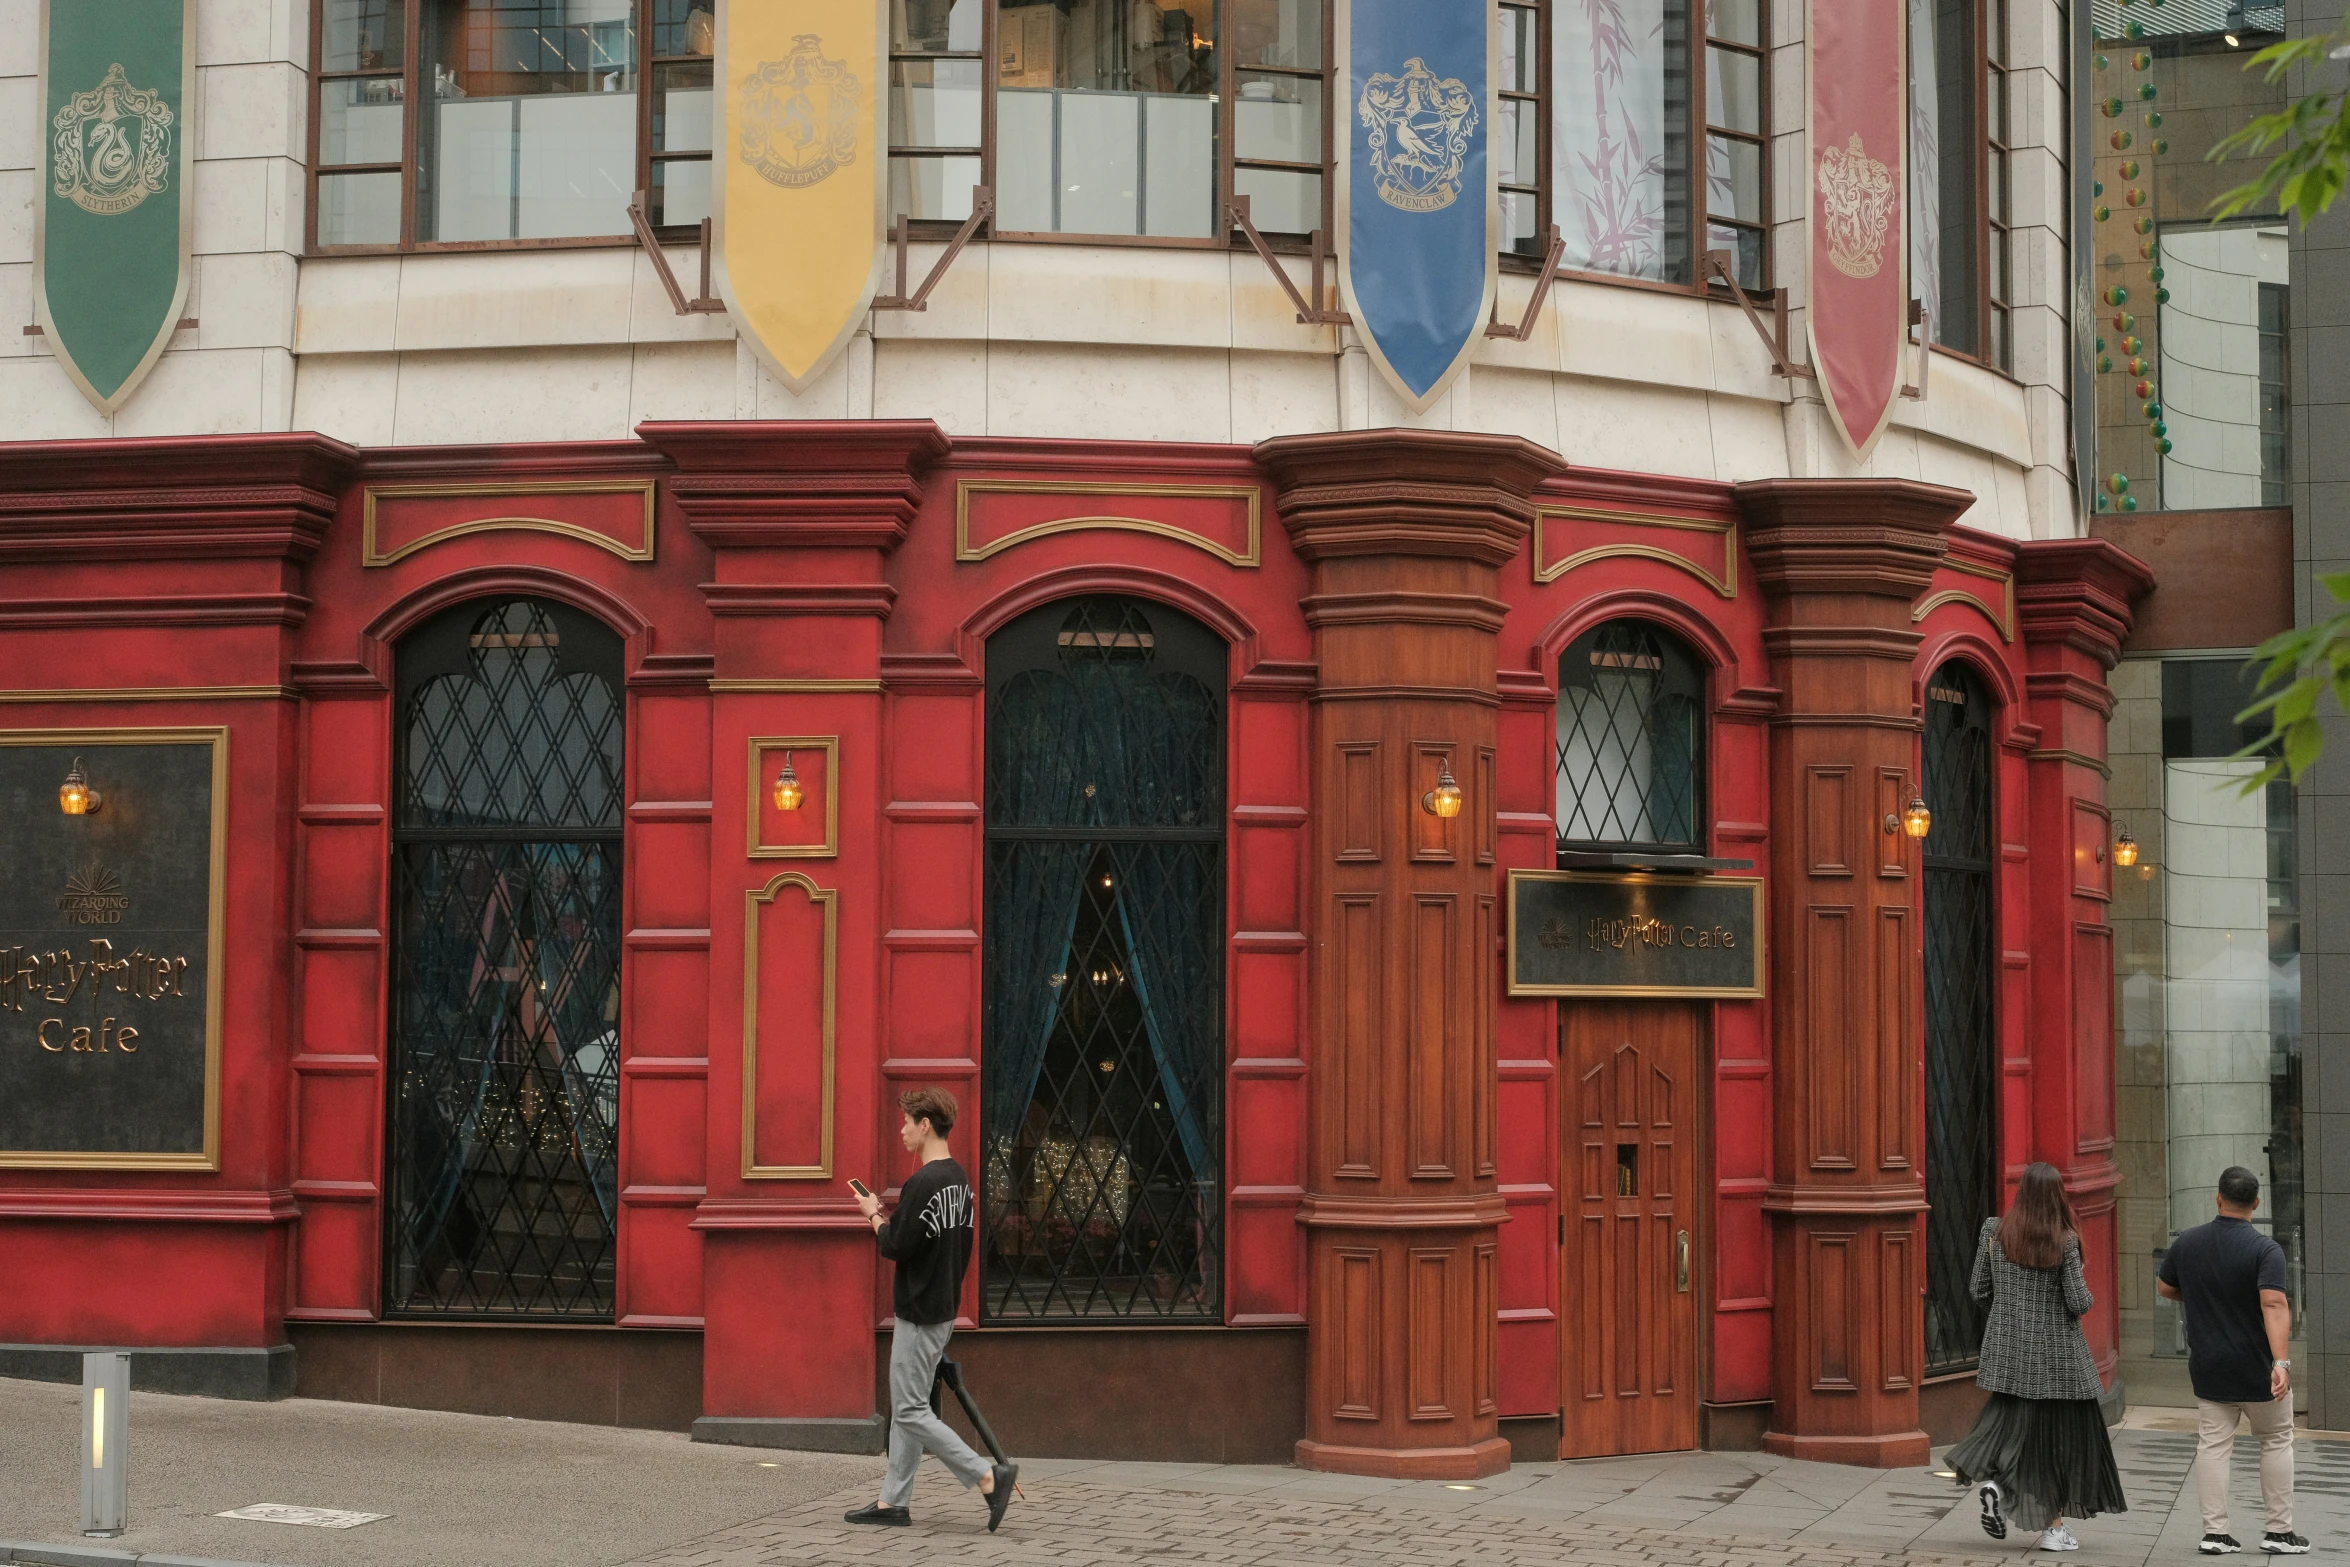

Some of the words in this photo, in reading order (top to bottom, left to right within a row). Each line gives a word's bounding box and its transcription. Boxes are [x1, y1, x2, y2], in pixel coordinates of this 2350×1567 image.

[761, 163, 830, 184] HUFFLEPUFF
[81, 191, 140, 211] SLYTHERIN
[1386, 190, 1446, 209] RAVENCLAW
[1832, 252, 1875, 275] GRYFFINDOR
[55, 897, 130, 911] WIZARDING
[63, 910, 121, 924] WORLD
[1586, 917, 1631, 952] Harry
[1631, 914, 1675, 956] Potter
[1680, 925, 1736, 948] Cafe
[89, 938, 188, 1013] Potter
[38, 1017, 140, 1053] Cafe
